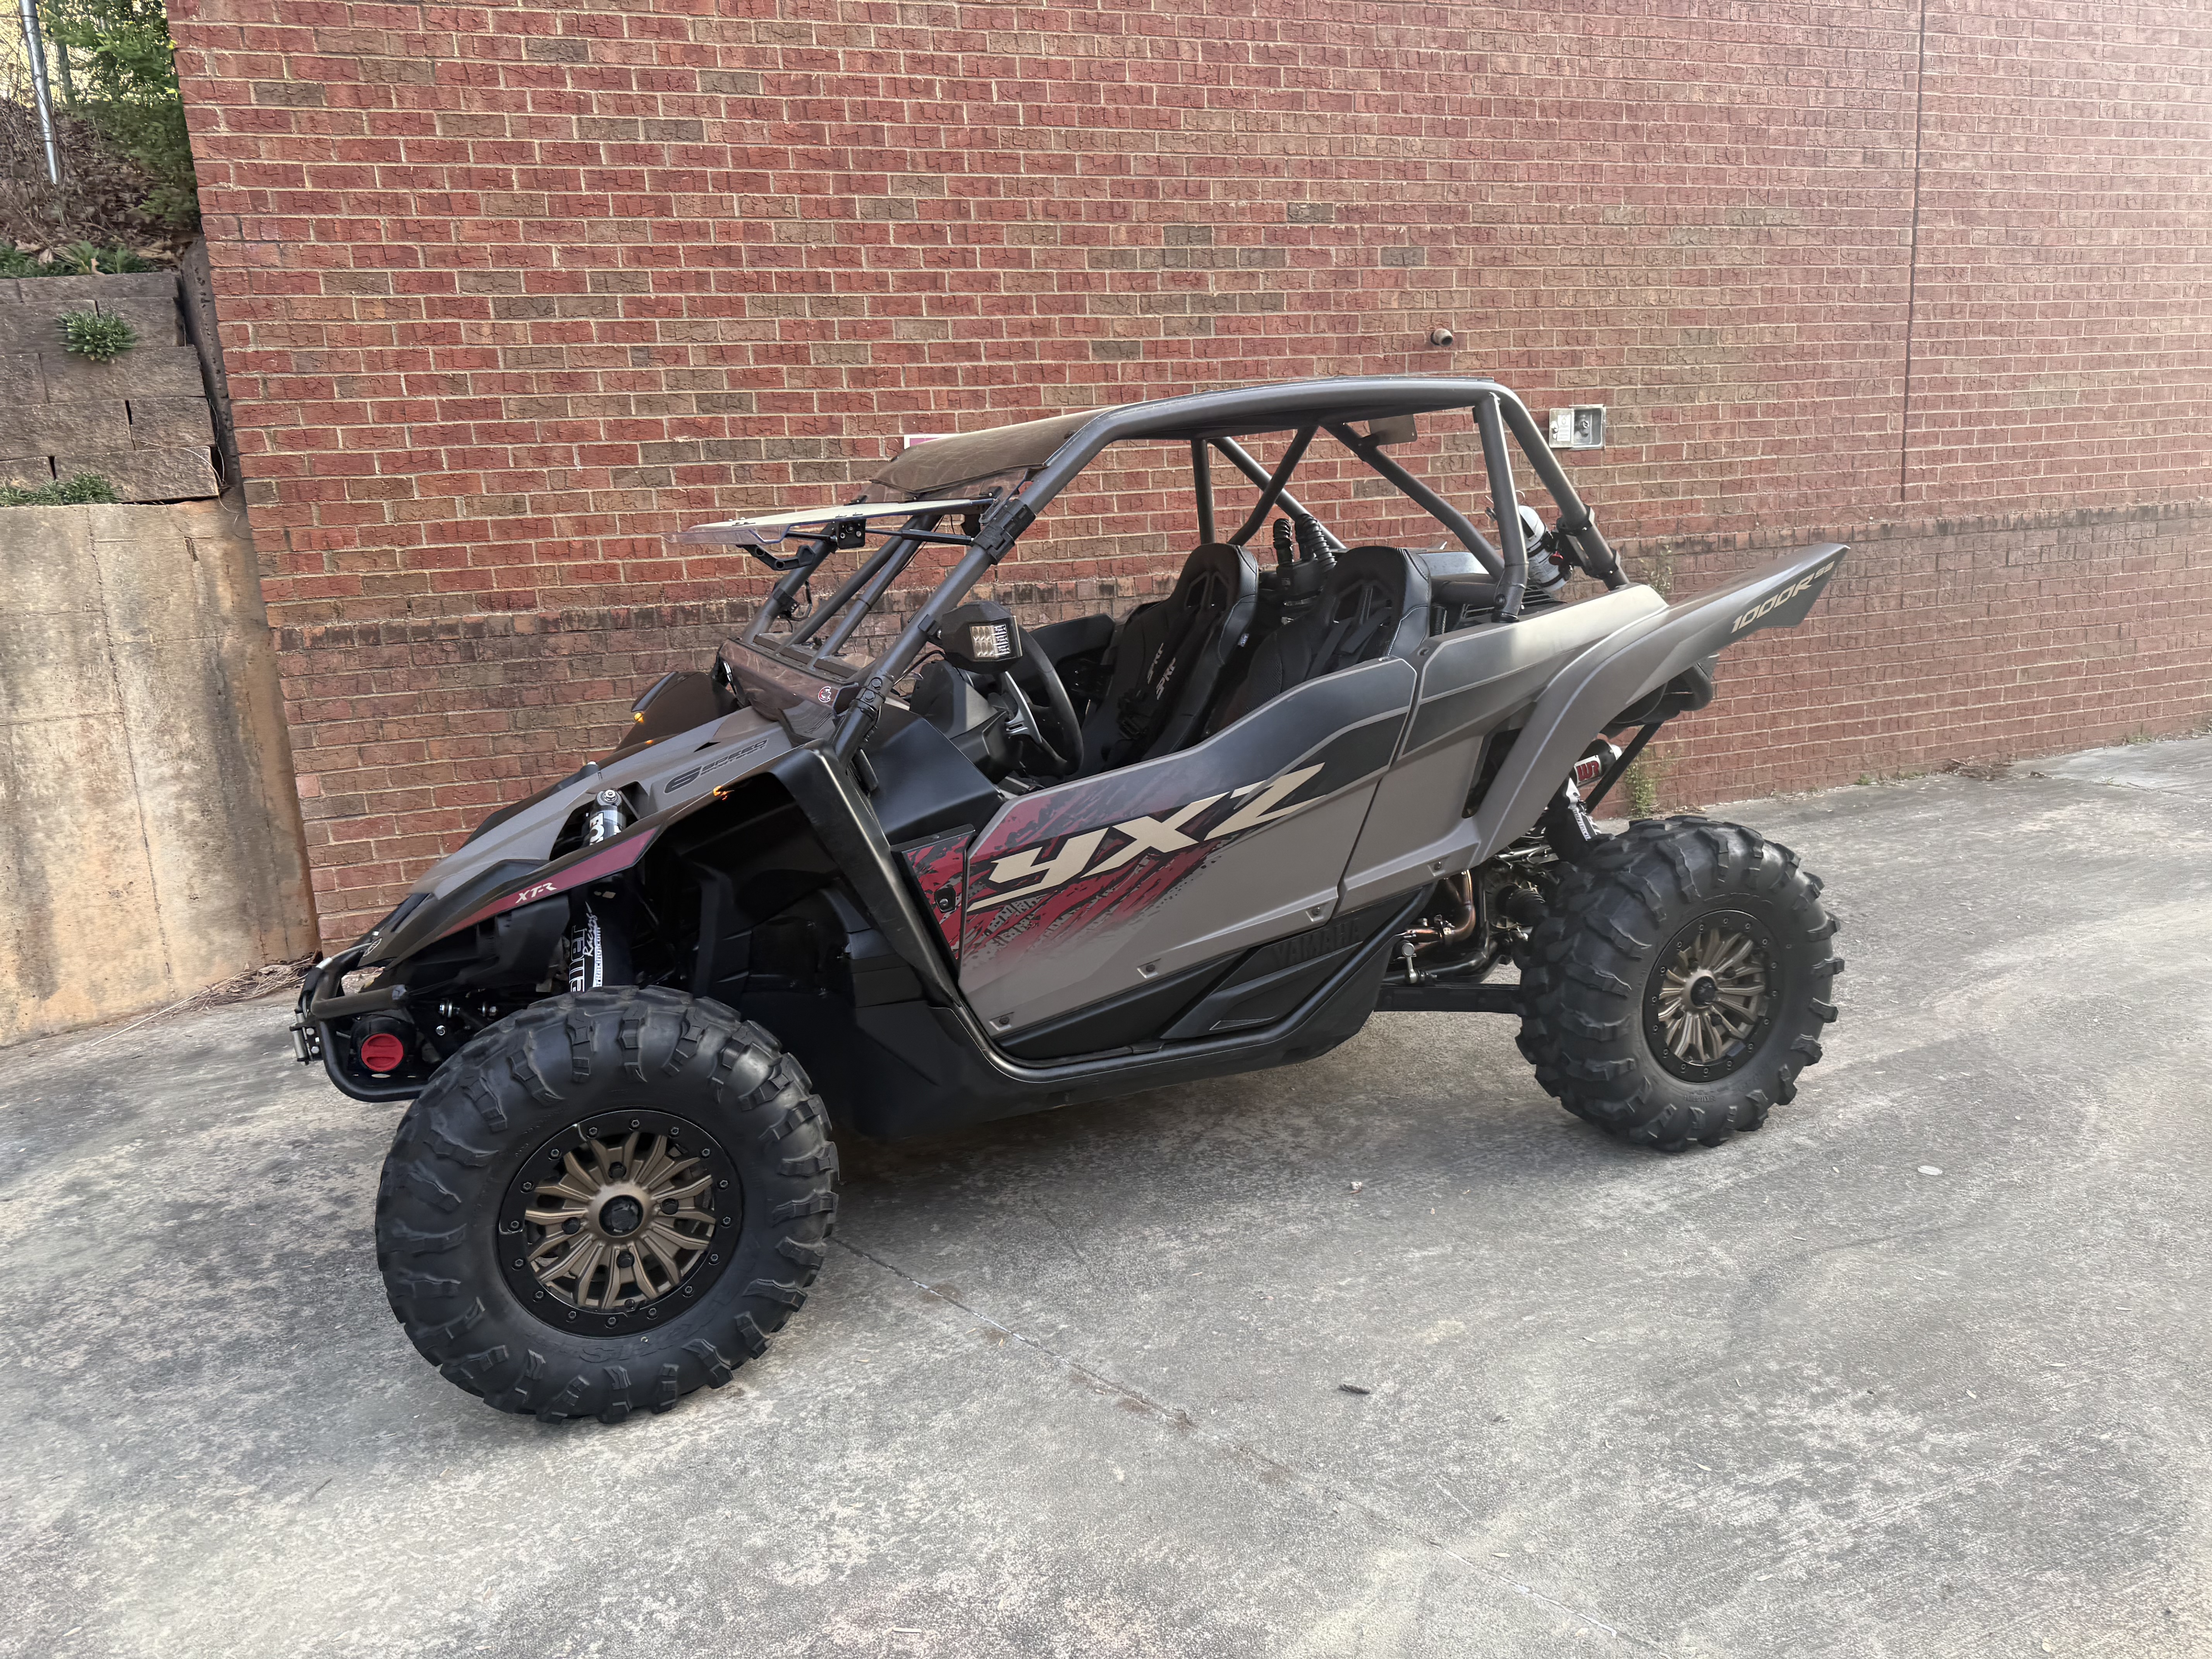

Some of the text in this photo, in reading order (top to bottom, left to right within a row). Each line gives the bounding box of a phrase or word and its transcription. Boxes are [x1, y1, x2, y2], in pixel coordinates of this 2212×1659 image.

[1731, 573, 1815, 634] 1000R
[664, 739, 768, 793] 6 SPEED
[966, 762, 1325, 912] YXZ
[582, 910, 598, 957] Racing
